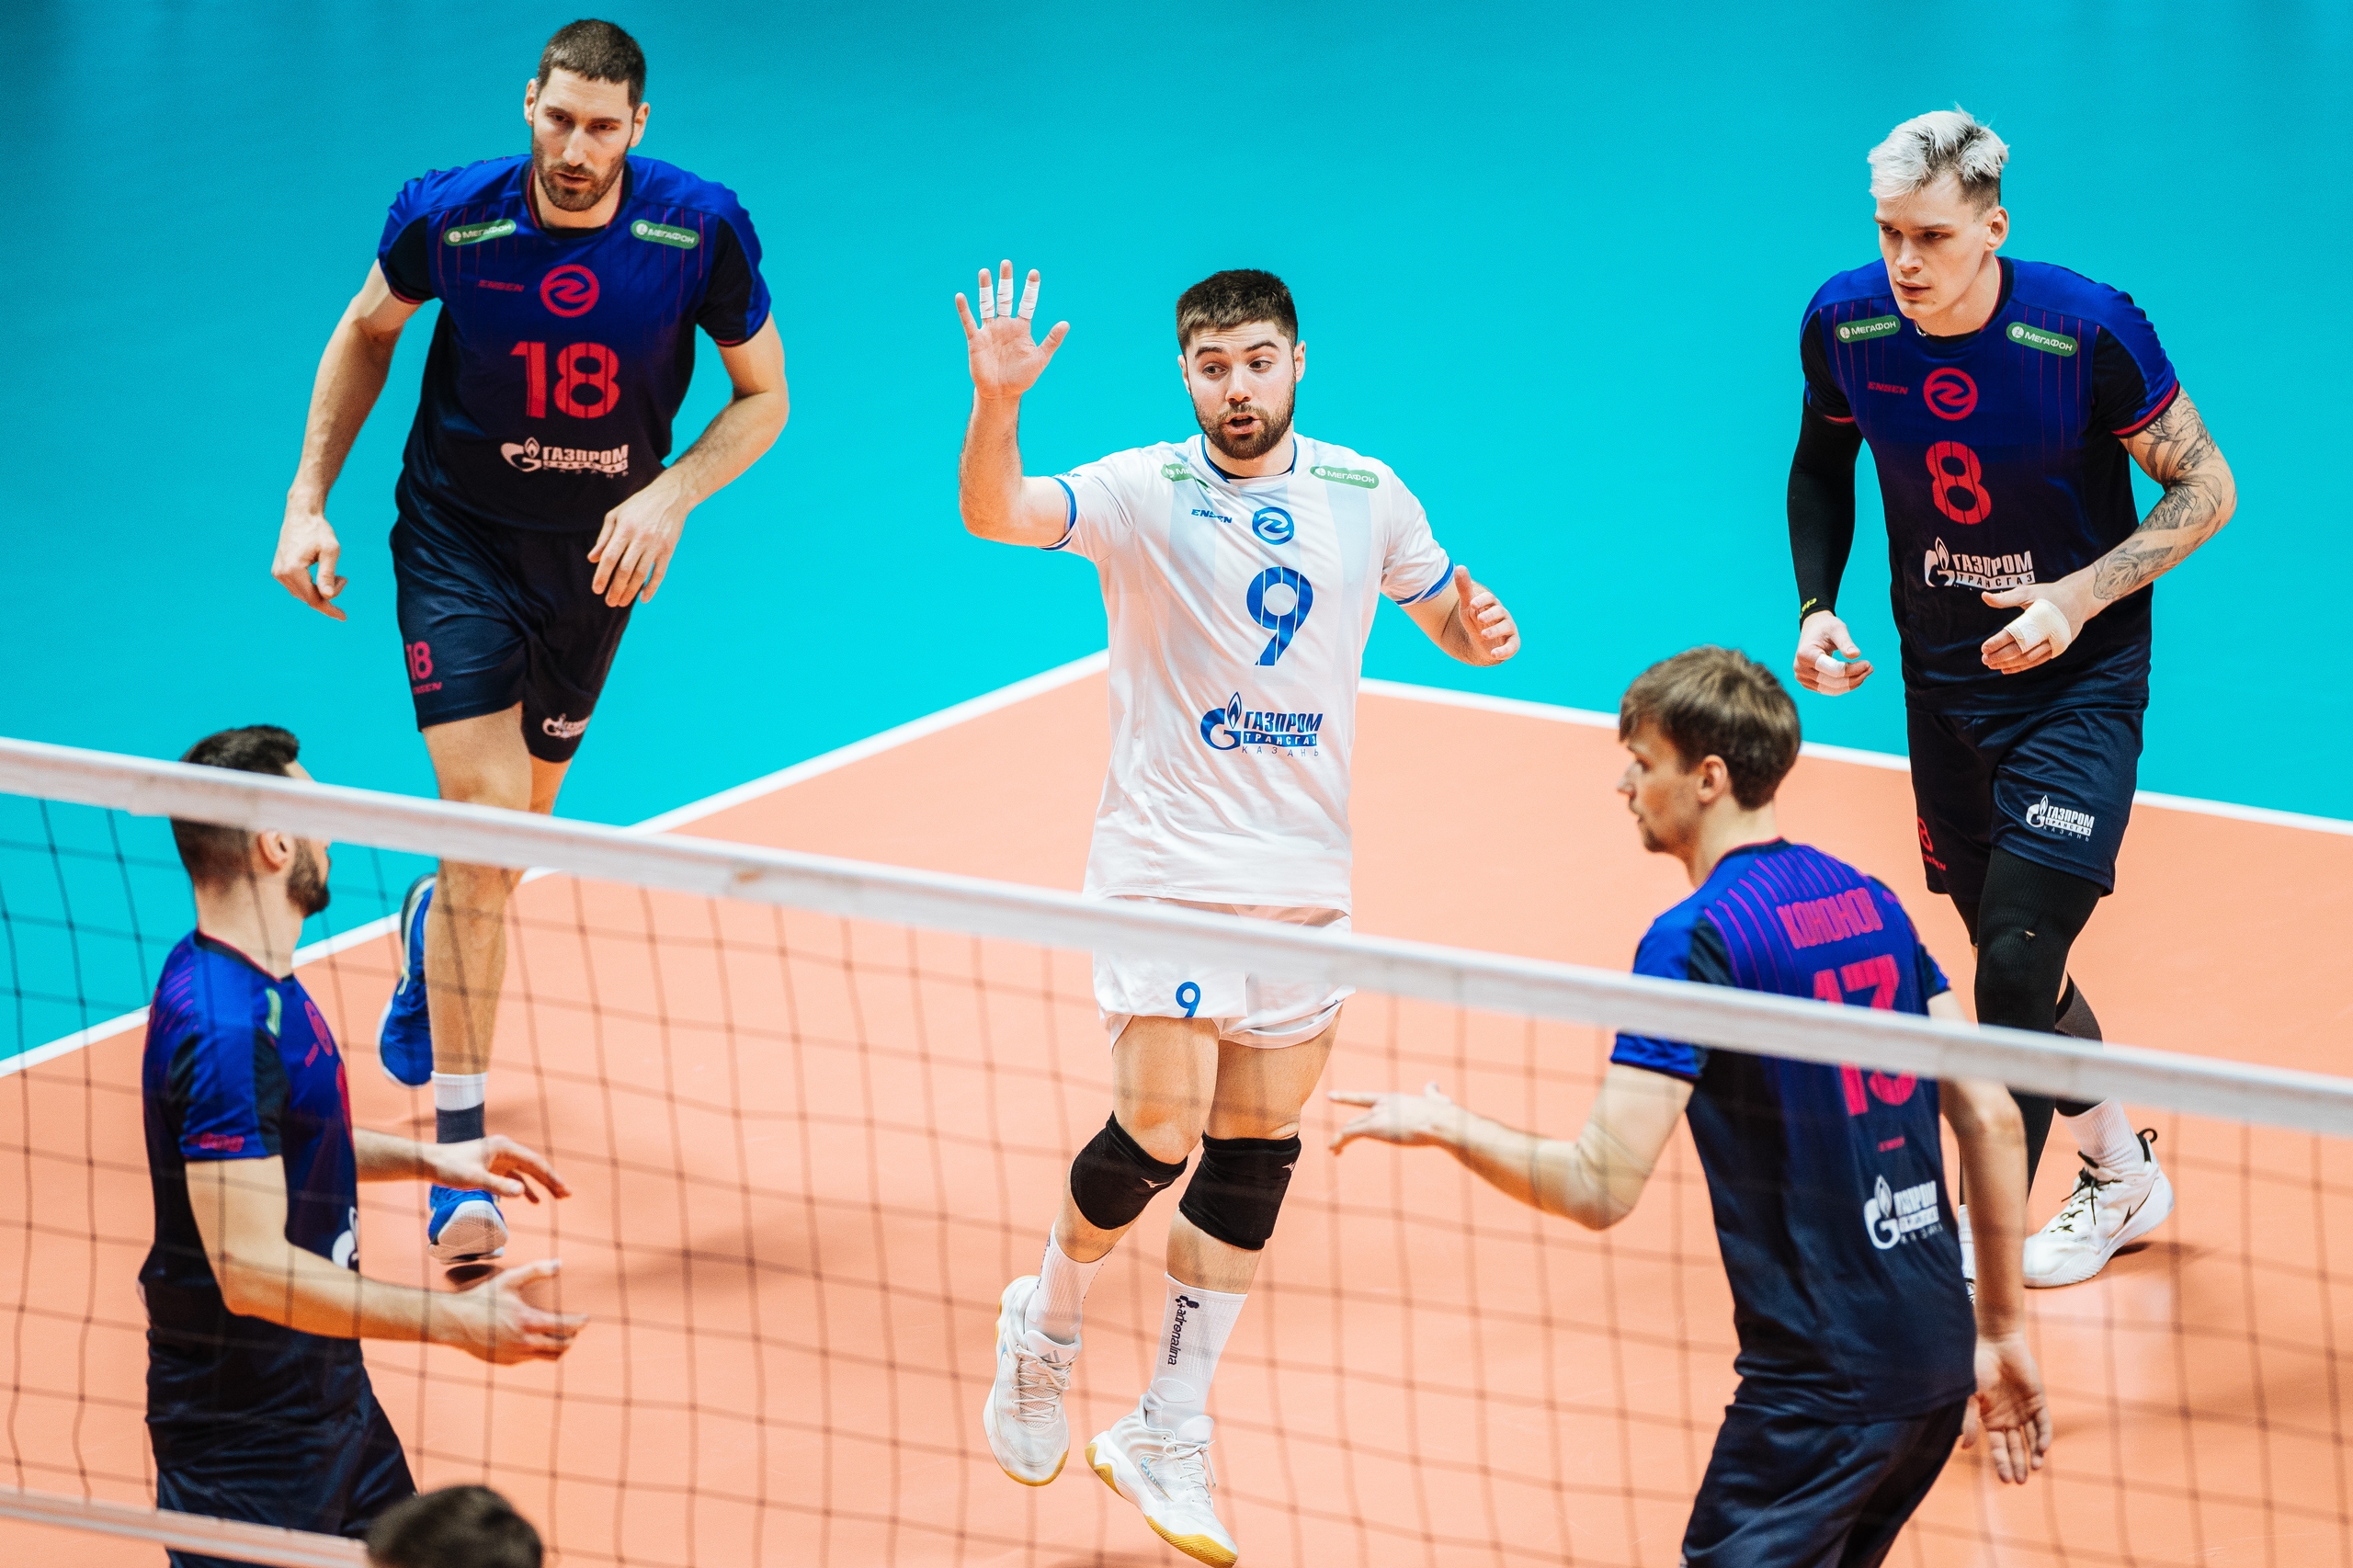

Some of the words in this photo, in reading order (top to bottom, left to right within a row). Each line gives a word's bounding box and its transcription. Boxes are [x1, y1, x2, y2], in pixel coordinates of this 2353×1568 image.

[1850, 321, 1896, 335] МЕГАФОН
[2024, 331, 2073, 351] МЕГАФОН
[509, 340, 621, 419] 18
[542, 444, 629, 464] ГАЗПРОМ
[1326, 470, 1375, 483] МЕГАФОН
[1926, 440, 1992, 525] 8
[1951, 551, 2033, 576] ГАЗПРОМ
[1958, 573, 2033, 588] ТРАНСГАЗ
[1245, 565, 1314, 666] 9
[405, 641, 434, 681] 18
[1244, 711, 1324, 733] ГАЗПРОМ
[1245, 733, 1316, 745] ТРАНСГАЗ
[1242, 745, 1319, 757] КАЗАНЬ
[2047, 805, 2095, 828] ГАЗПРОМ
[2043, 825, 2089, 842] КАЗАНЬ
[1176, 981, 1201, 1018] 9
